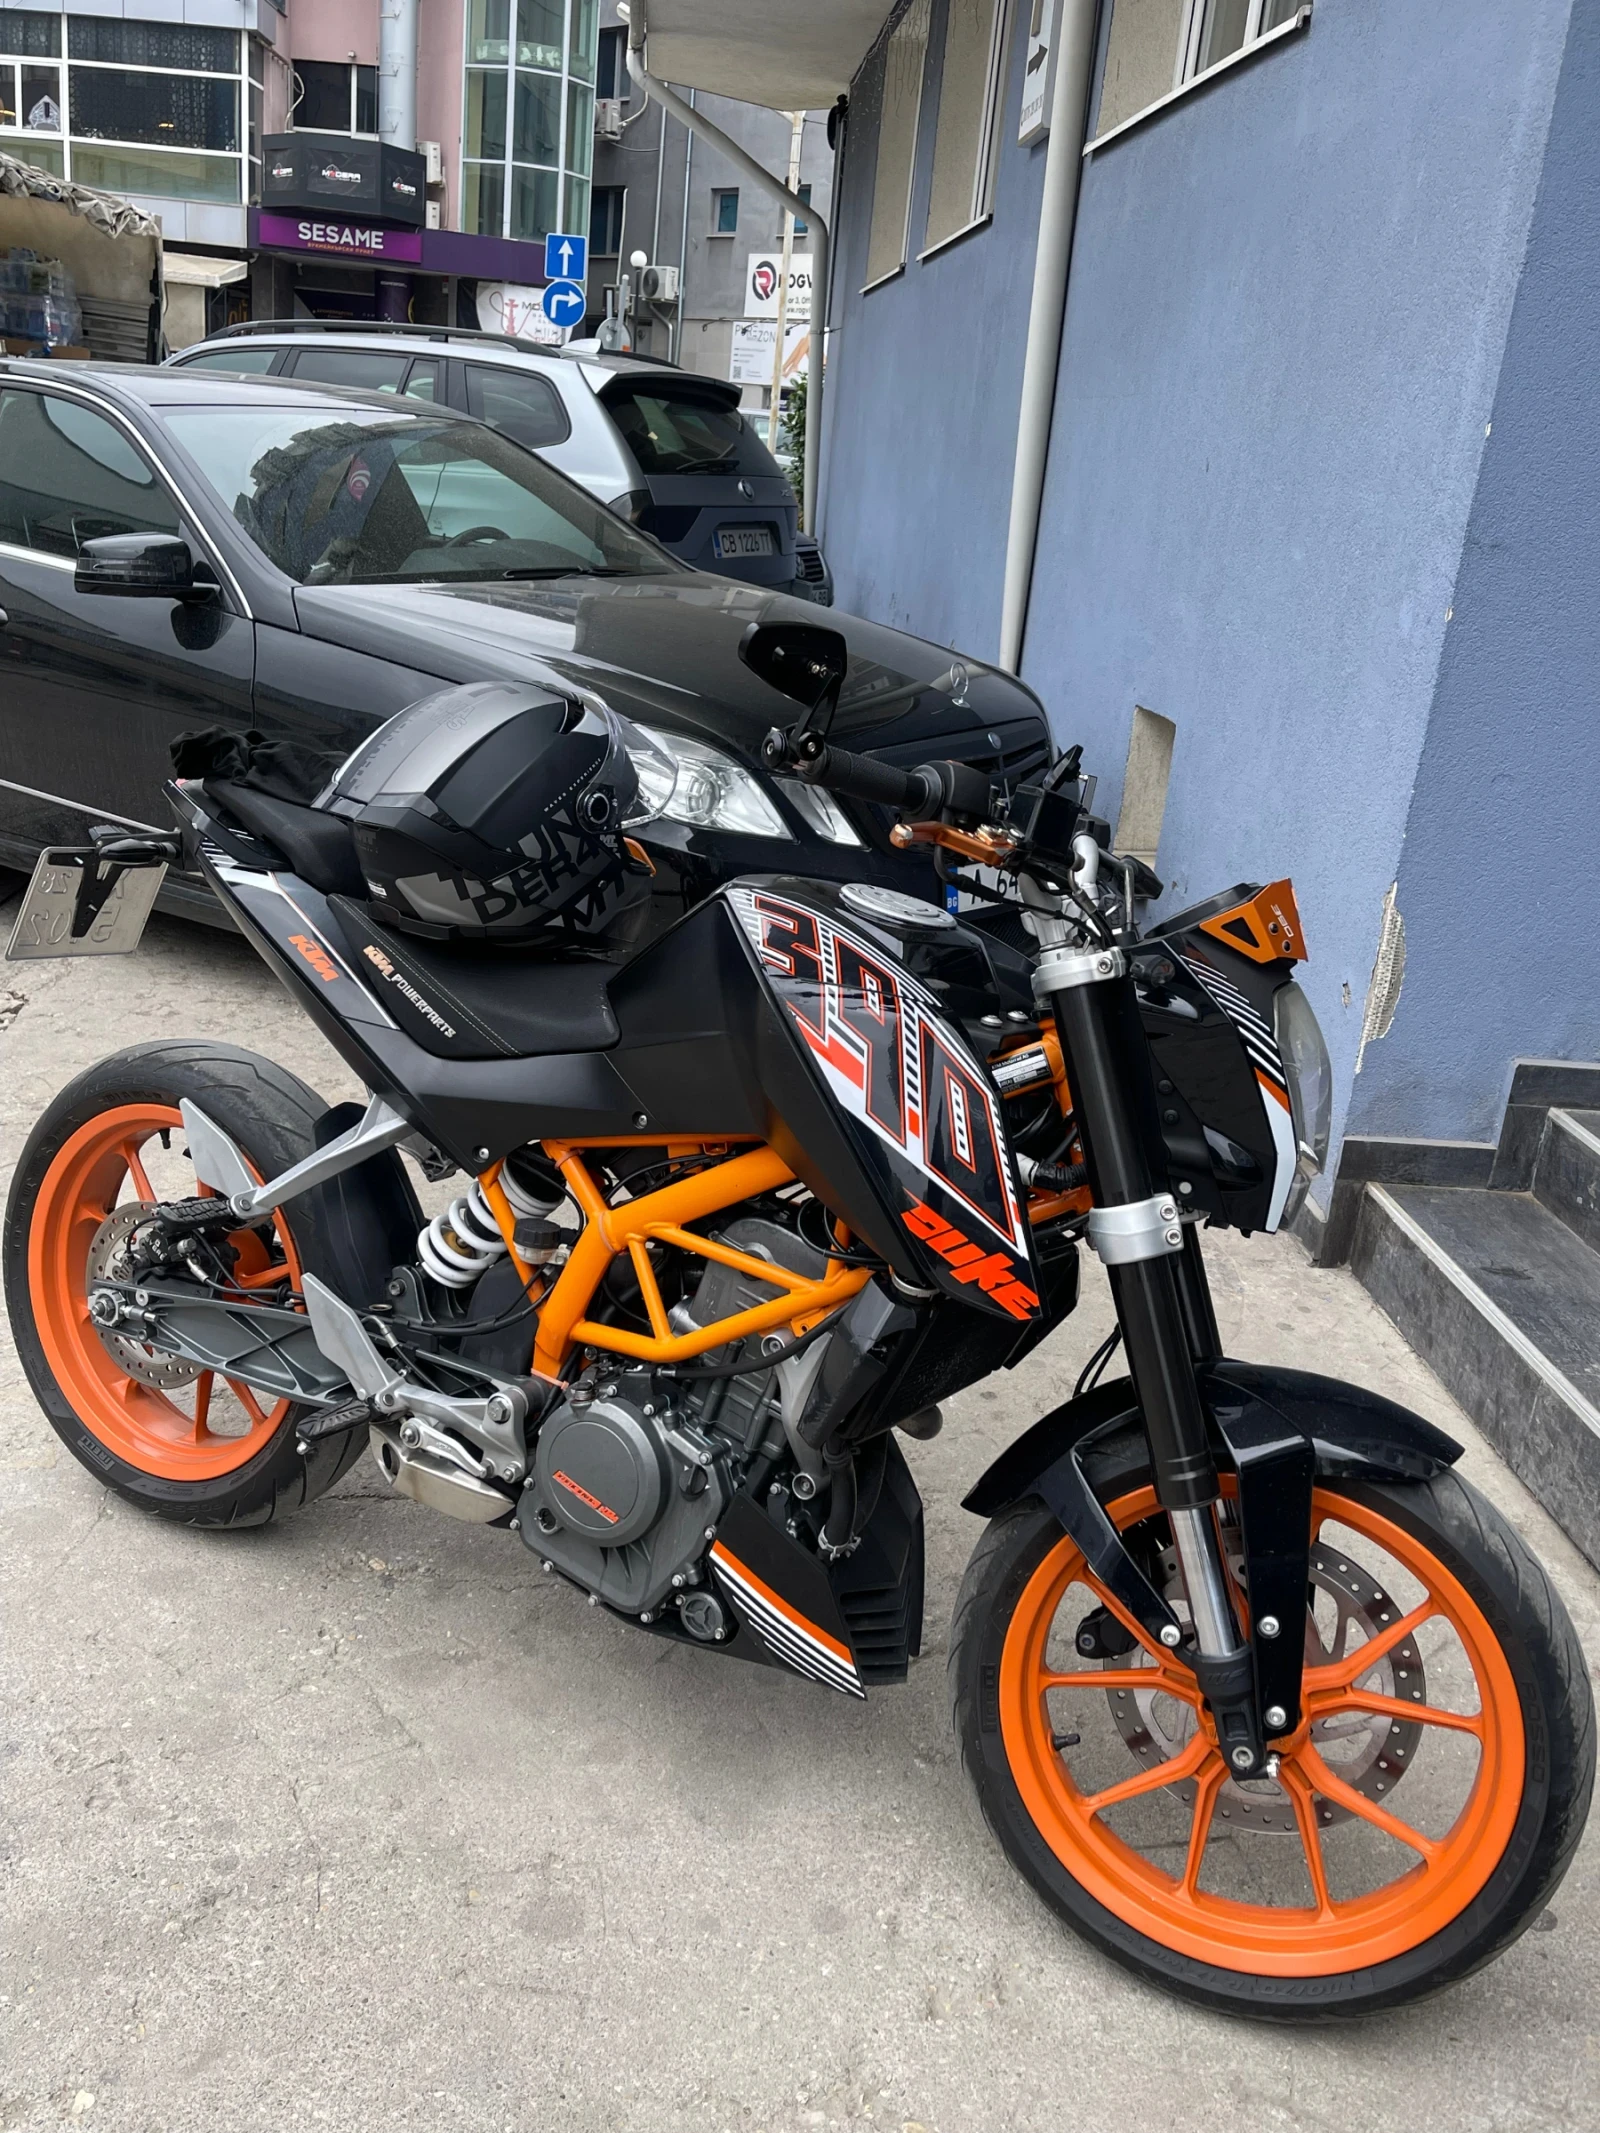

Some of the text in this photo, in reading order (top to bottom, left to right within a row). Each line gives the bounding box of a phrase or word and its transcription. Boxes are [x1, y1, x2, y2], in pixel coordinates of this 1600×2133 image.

[298, 222, 384, 249] SESAME
[721, 534, 737, 553] CB
[738, 532, 760, 553] 1226
[946, 896, 957, 909] BG
[1270, 903, 1295, 938] 390
[288, 934, 339, 982] KTM
[901, 1190, 1041, 1321] DUKE
[77, 1434, 115, 1470] PIRELLI
